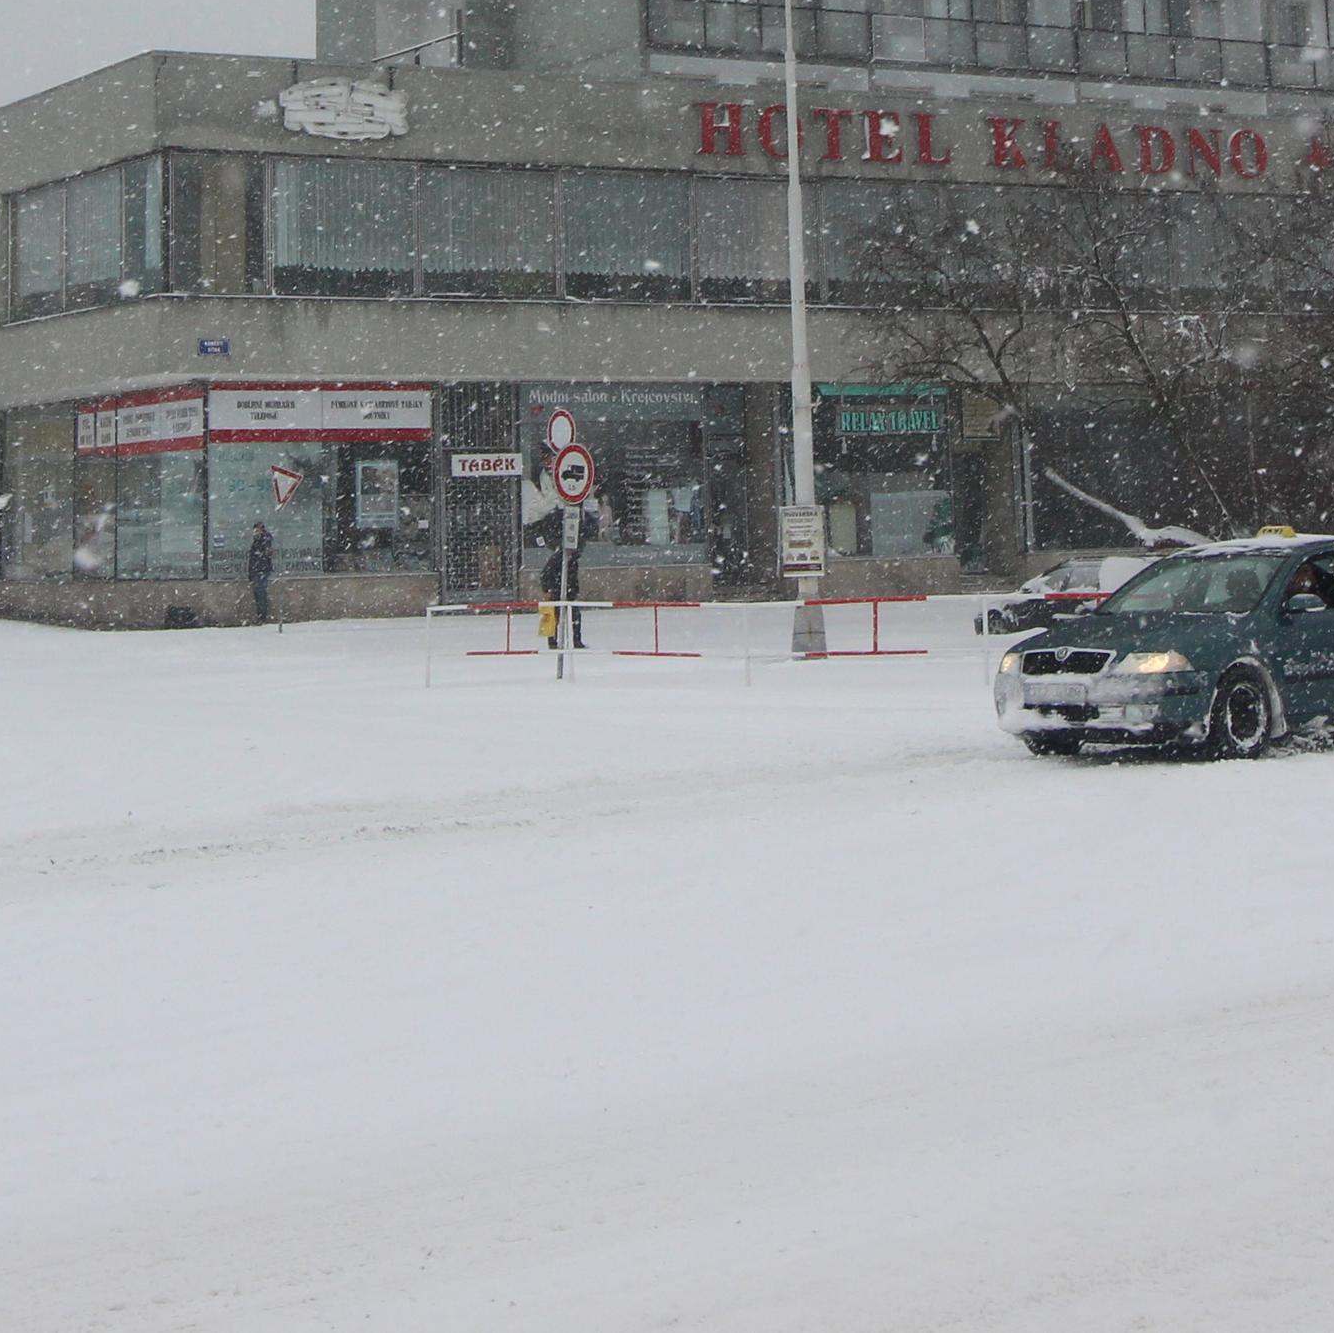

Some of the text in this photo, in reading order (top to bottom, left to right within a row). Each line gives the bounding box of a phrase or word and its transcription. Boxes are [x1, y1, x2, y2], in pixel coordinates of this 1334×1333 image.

[693, 101, 1267, 179] HOTEL KLADNO
[840, 409, 940, 433] RELAX TRAVEL
